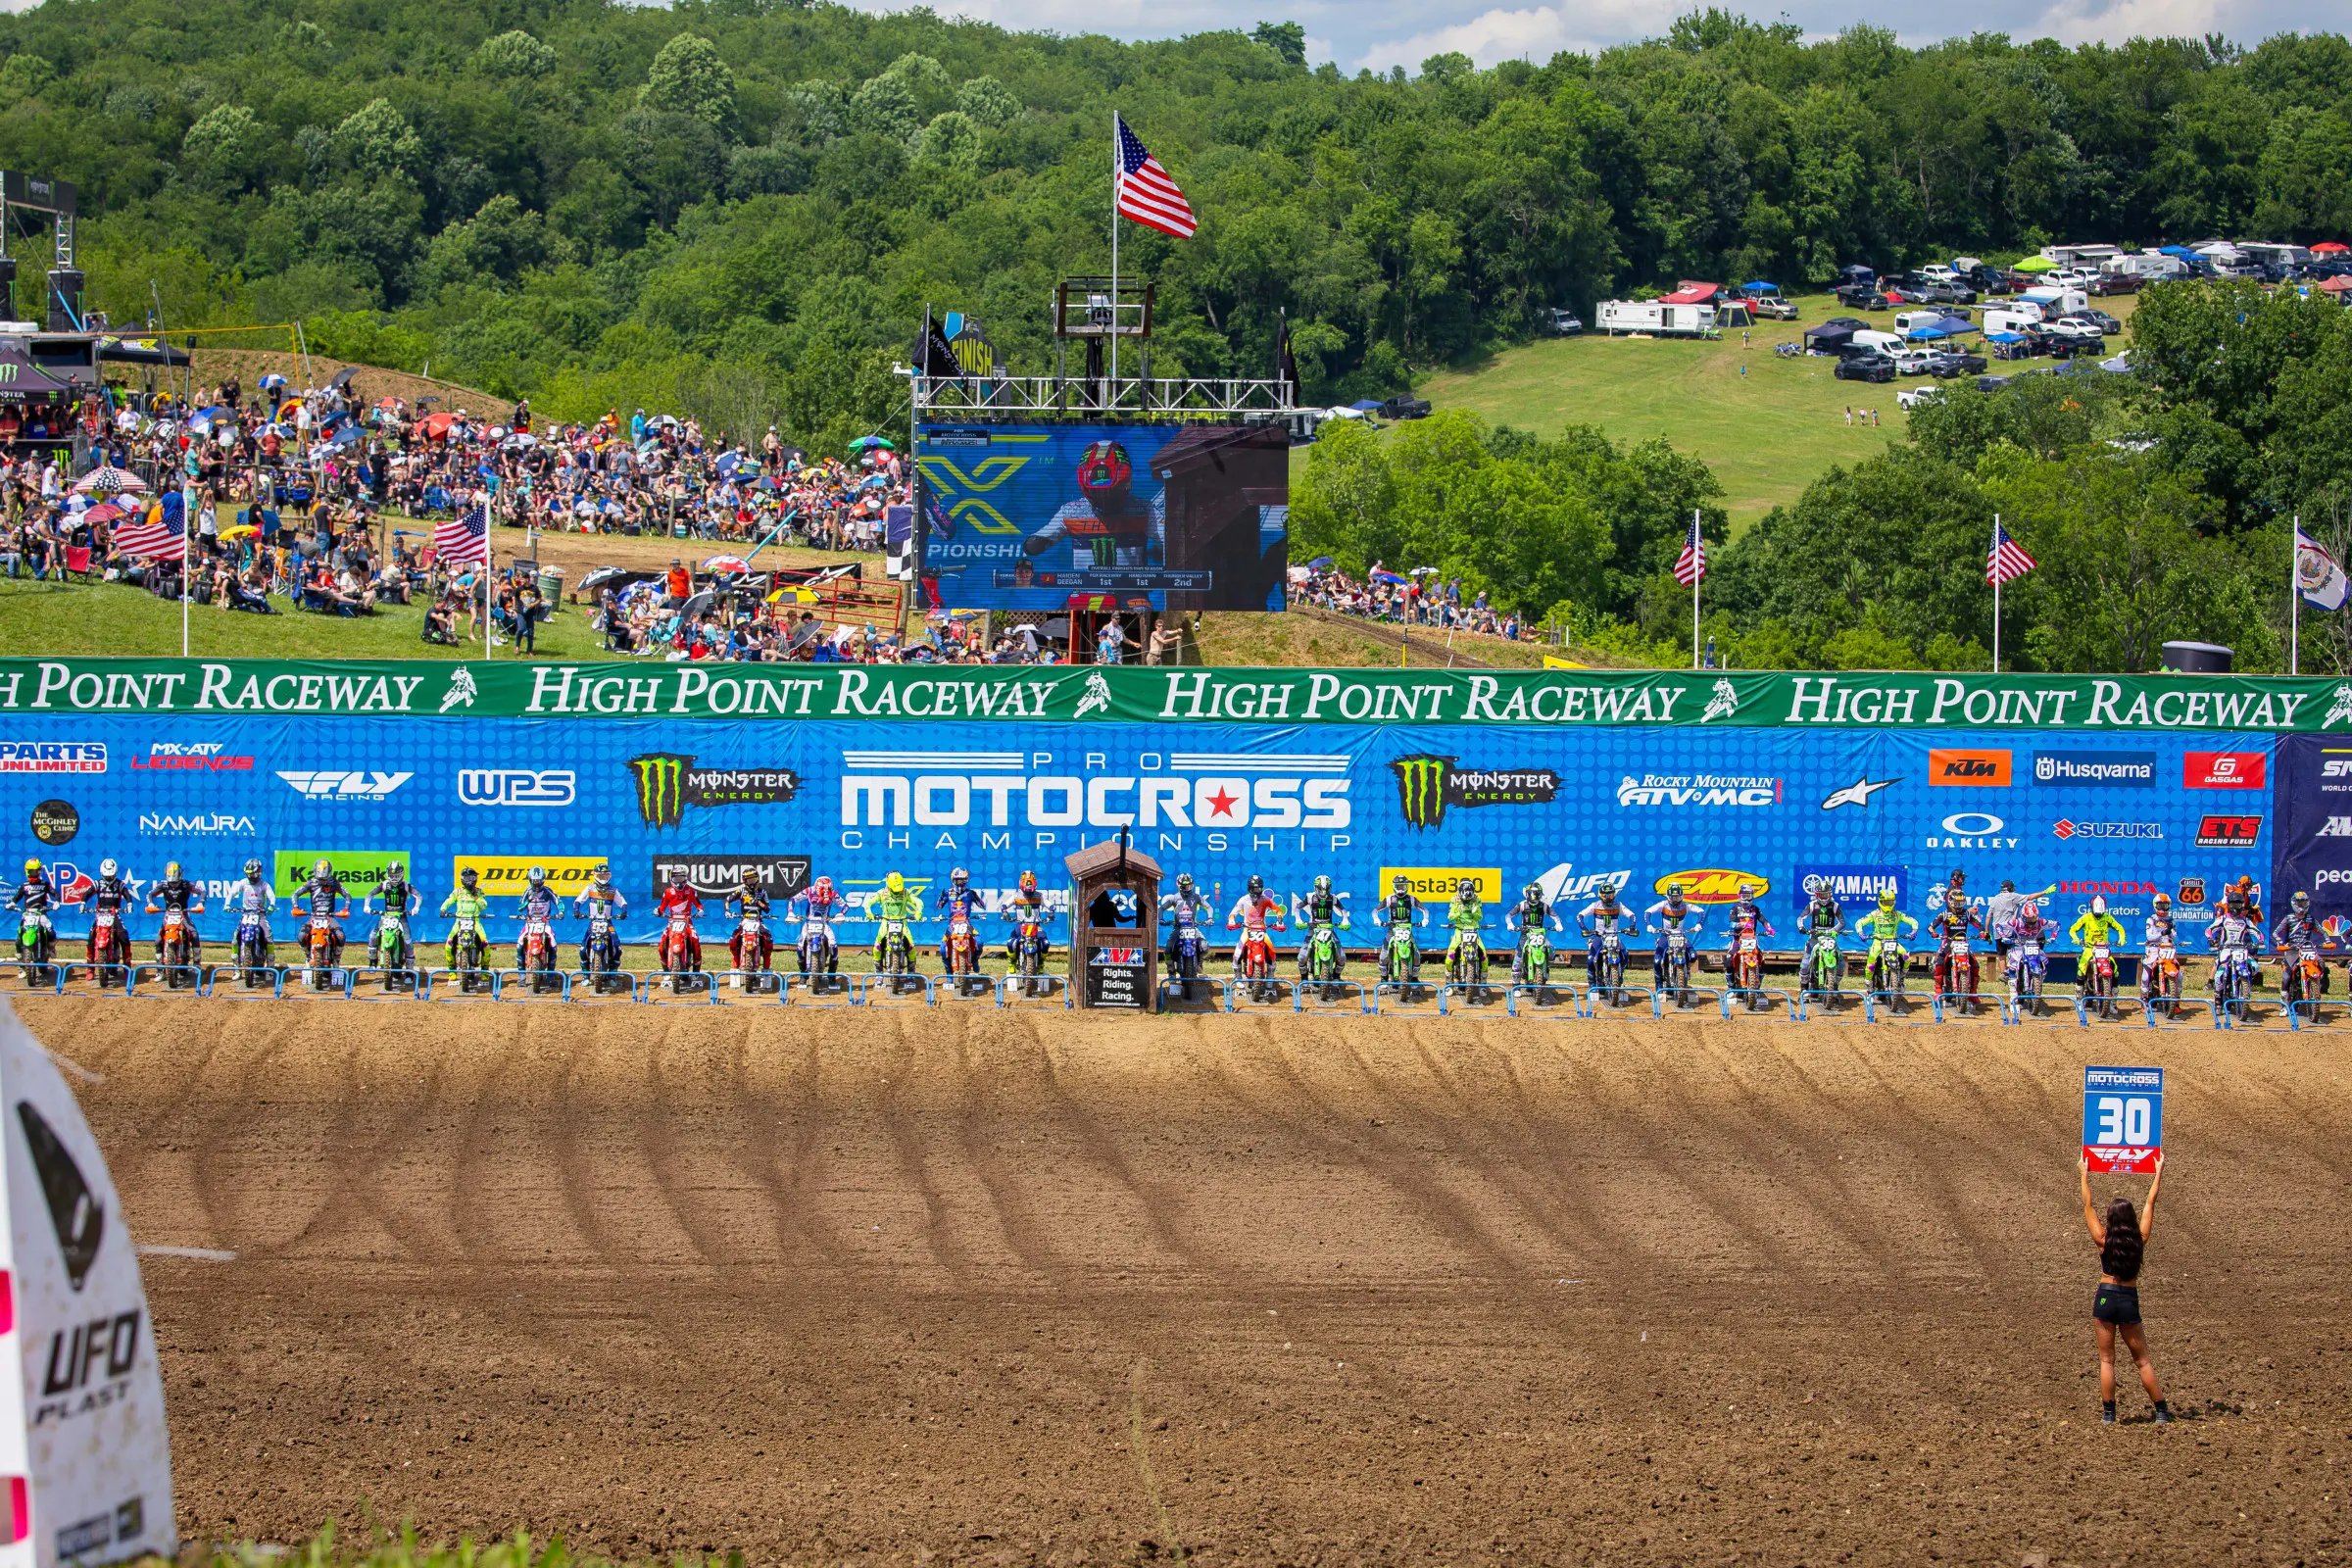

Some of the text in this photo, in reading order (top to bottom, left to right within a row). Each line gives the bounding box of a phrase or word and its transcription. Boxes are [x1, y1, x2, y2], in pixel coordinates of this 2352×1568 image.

[927, 544, 1028, 558] PIONSHI
[1174, 578, 1193, 587] 2nd
[30, 662, 186, 709] POINT
[193, 663, 424, 711] RACEWAY
[524, 666, 1059, 716] HIGH POINT RACEWAY
[1157, 672, 1687, 721] HIGH POINT RACEWAY
[1784, 677, 2308, 727] HIGH POINT RACEWAY
[0, 744, 106, 760] PARTS
[151, 743, 182, 756] MX
[186, 743, 224, 756] ATV
[130, 755, 256, 773] LEGENDS
[1032, 752, 1162, 771] PRO
[1943, 759, 1997, 777] KTM
[2057, 760, 2151, 781] Husqvarna
[274, 770, 416, 795] FLY
[460, 771, 574, 805] WPS
[1642, 774, 1774, 788] ROCKY MOUNTAIN
[841, 775, 1352, 828] MOTOCROSS
[139, 810, 256, 832] NAMURA
[2201, 817, 2260, 838] ETS
[2076, 821, 2160, 839] SUZUKI
[1926, 837, 2019, 849] OAKLEY
[1559, 869, 1632, 897] UFO
[1824, 875, 1899, 895] YAMAHA
[2059, 880, 2159, 895] HONDA
[2181, 887, 2202, 903] 66
[98, 914, 116, 926] 195
[460, 919, 474, 930] 22
[670, 920, 686, 932] 10
[1180, 928, 1196, 939] 302
[1250, 931, 1264, 941] 30
[1316, 930, 1332, 940] 47
[1529, 934, 1544, 946] 26
[1820, 939, 1836, 951] 36
[2025, 946, 2040, 956] 186
[1089, 948, 1145, 964] AMA
[2300, 951, 2317, 960] 775
[1102, 967, 1134, 978] Rights.
[1102, 979, 1134, 990] Riding.
[1102, 991, 1134, 1002] Racing.
[2087, 1074, 2160, 1084] MOTOCROSS
[2097, 1097, 2151, 1146] 30
[2087, 1147, 2155, 1160] FLY
[43, 1310, 140, 1396] UFO
[34, 1378, 132, 1425] PLAST
